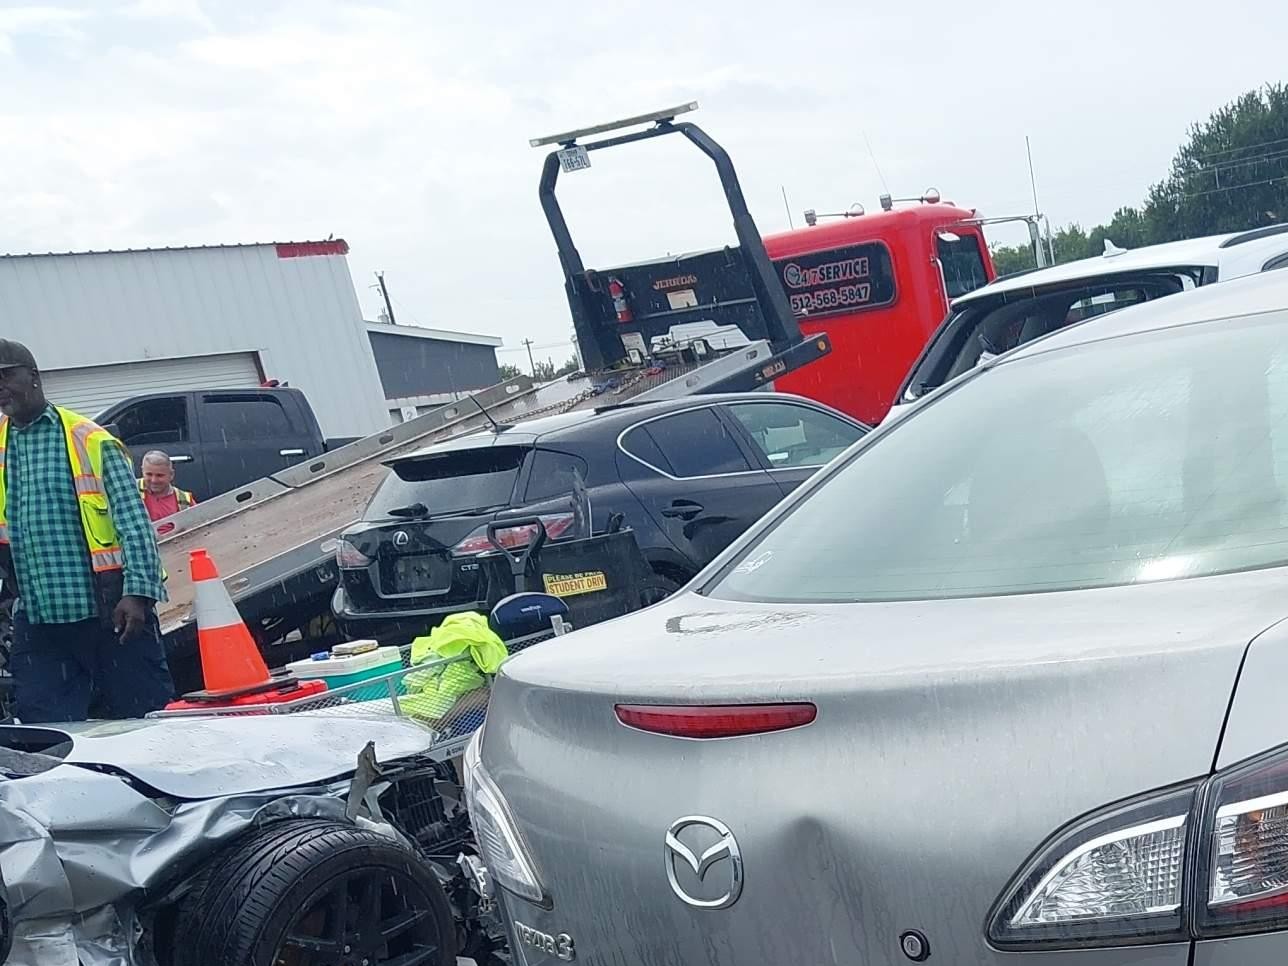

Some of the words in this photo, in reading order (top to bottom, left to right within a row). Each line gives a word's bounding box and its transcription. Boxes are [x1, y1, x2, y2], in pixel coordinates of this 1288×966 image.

[818, 257, 869, 283] SERVICE
[789, 282, 871, 313] 512-568-5847
[549, 578, 585, 595] STUDENT
